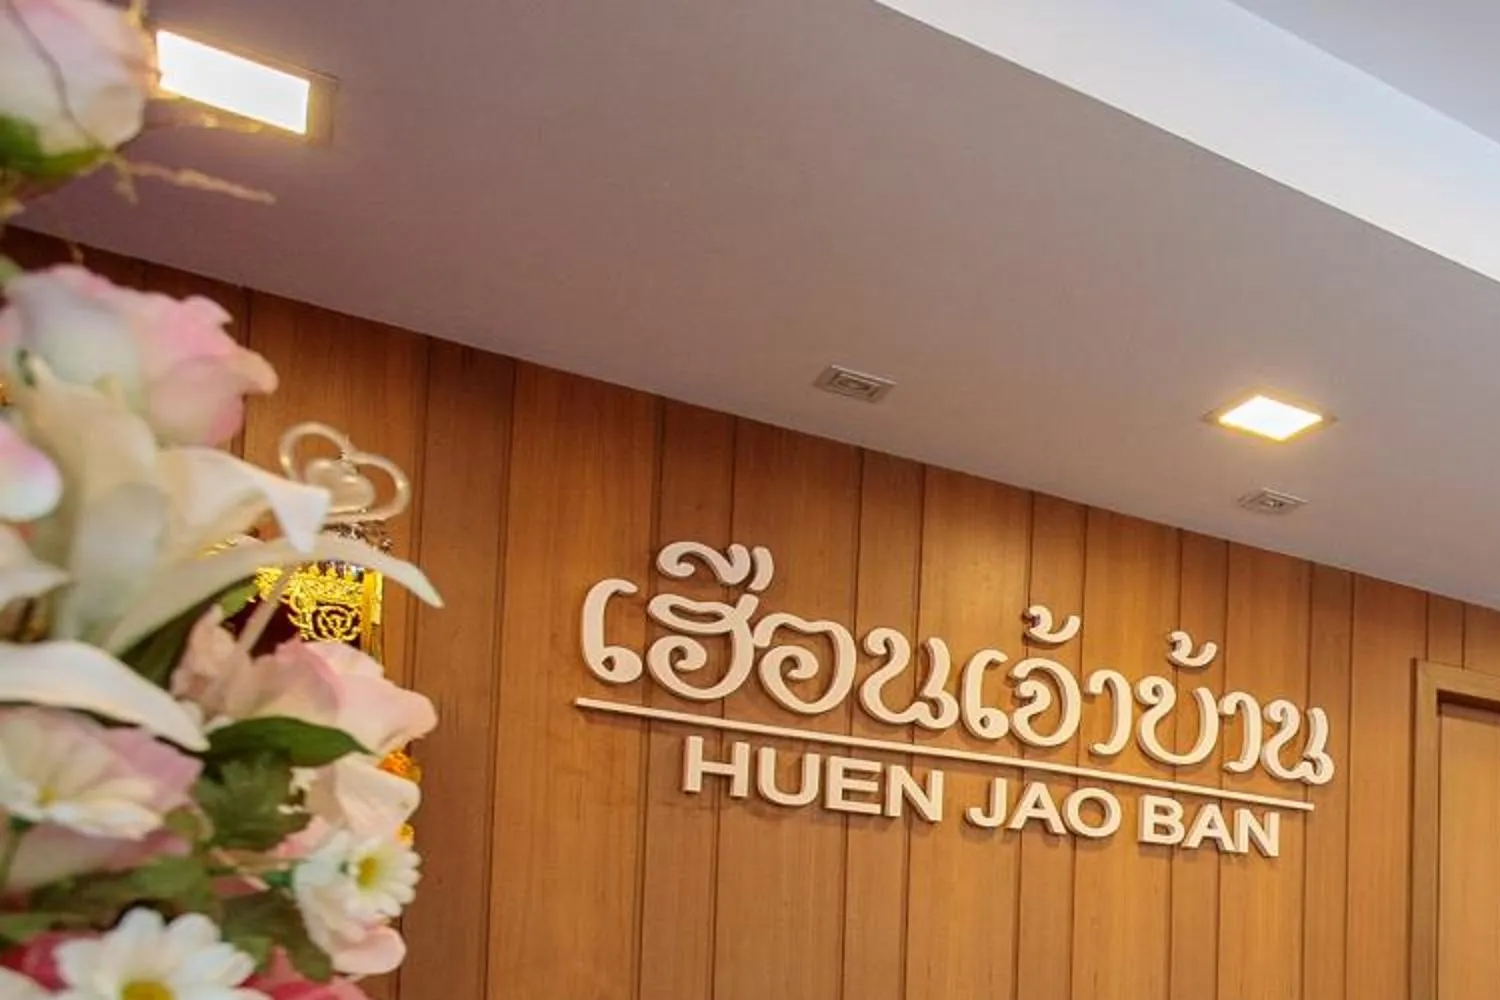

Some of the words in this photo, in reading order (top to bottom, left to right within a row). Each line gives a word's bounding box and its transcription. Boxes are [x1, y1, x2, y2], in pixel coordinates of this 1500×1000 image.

[683, 736, 943, 822] HUEN
[965, 777, 1123, 839] JAO
[1138, 794, 1281, 857] BAN
